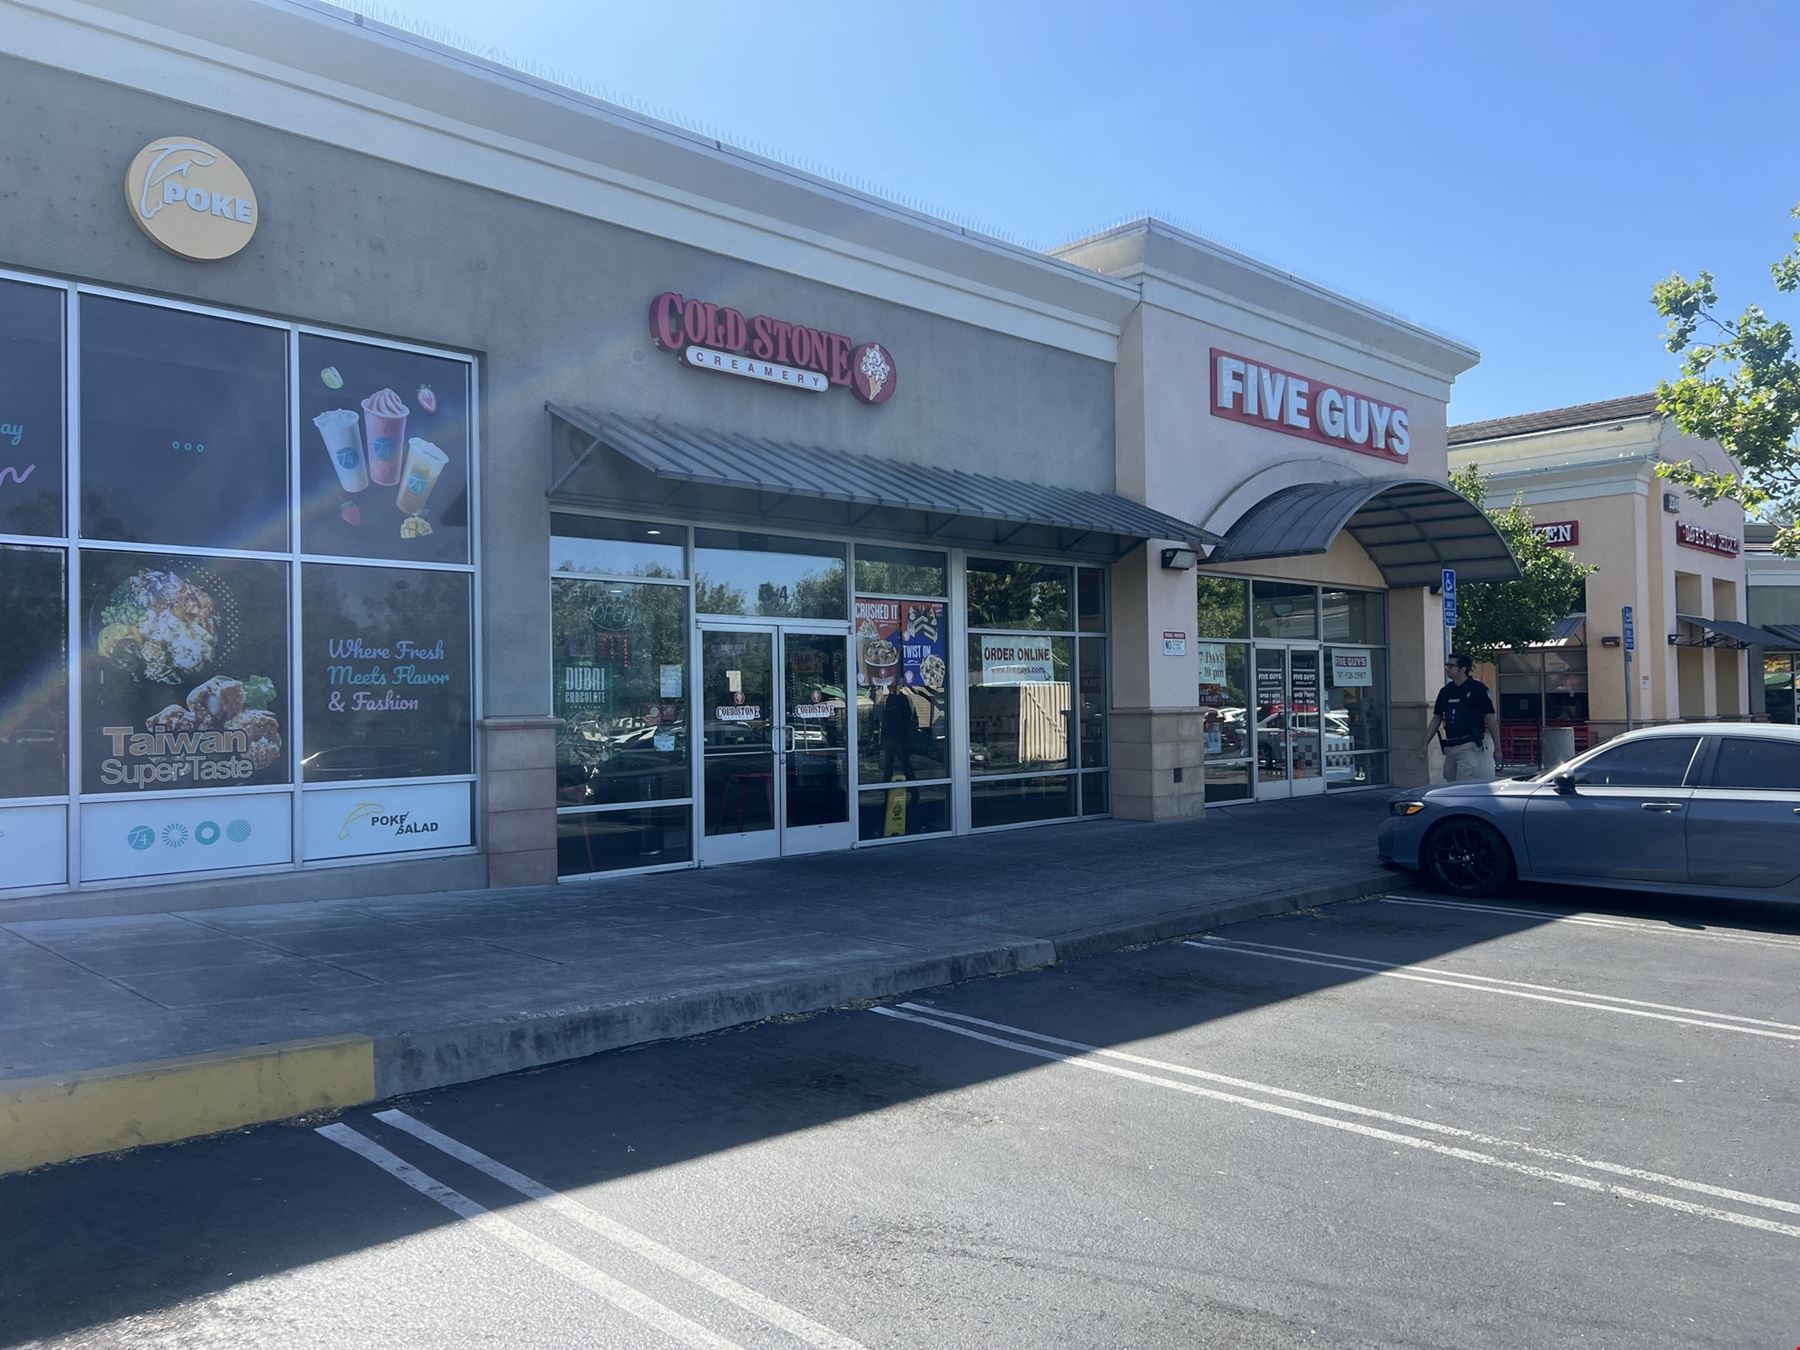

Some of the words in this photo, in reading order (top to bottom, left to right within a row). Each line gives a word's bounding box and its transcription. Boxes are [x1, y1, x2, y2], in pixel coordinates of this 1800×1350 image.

[162, 181, 252, 223] POKE
[650, 291, 747, 350] COLD
[752, 315, 852, 386] STONE
[696, 352, 819, 386] CREAMERY
[1217, 355, 1310, 429] FIVE
[1316, 388, 1410, 455] GUYS
[856, 603, 889, 619] CRUSHED
[891, 605, 898, 620] IT
[329, 638, 390, 659] Where
[395, 640, 444, 660] Fresh
[903, 645, 921, 658] TWIST
[984, 647, 1015, 660] ORDER
[1017, 648, 1051, 661] ONLINE
[1206, 652, 1225, 664] DAYS
[1347, 657, 1366, 667] GUYS
[326, 665, 386, 685] Meets
[391, 664, 450, 685] Flavor
[565, 667, 605, 690] DUBAI
[328, 691, 345, 712] &
[351, 689, 418, 711] Fashion
[565, 691, 606, 703] CHOCOLATE
[103, 725, 247, 757] Taiwan
[101, 758, 184, 789] Super
[186, 755, 253, 781] Taste
[397, 821, 439, 835] SALAD
